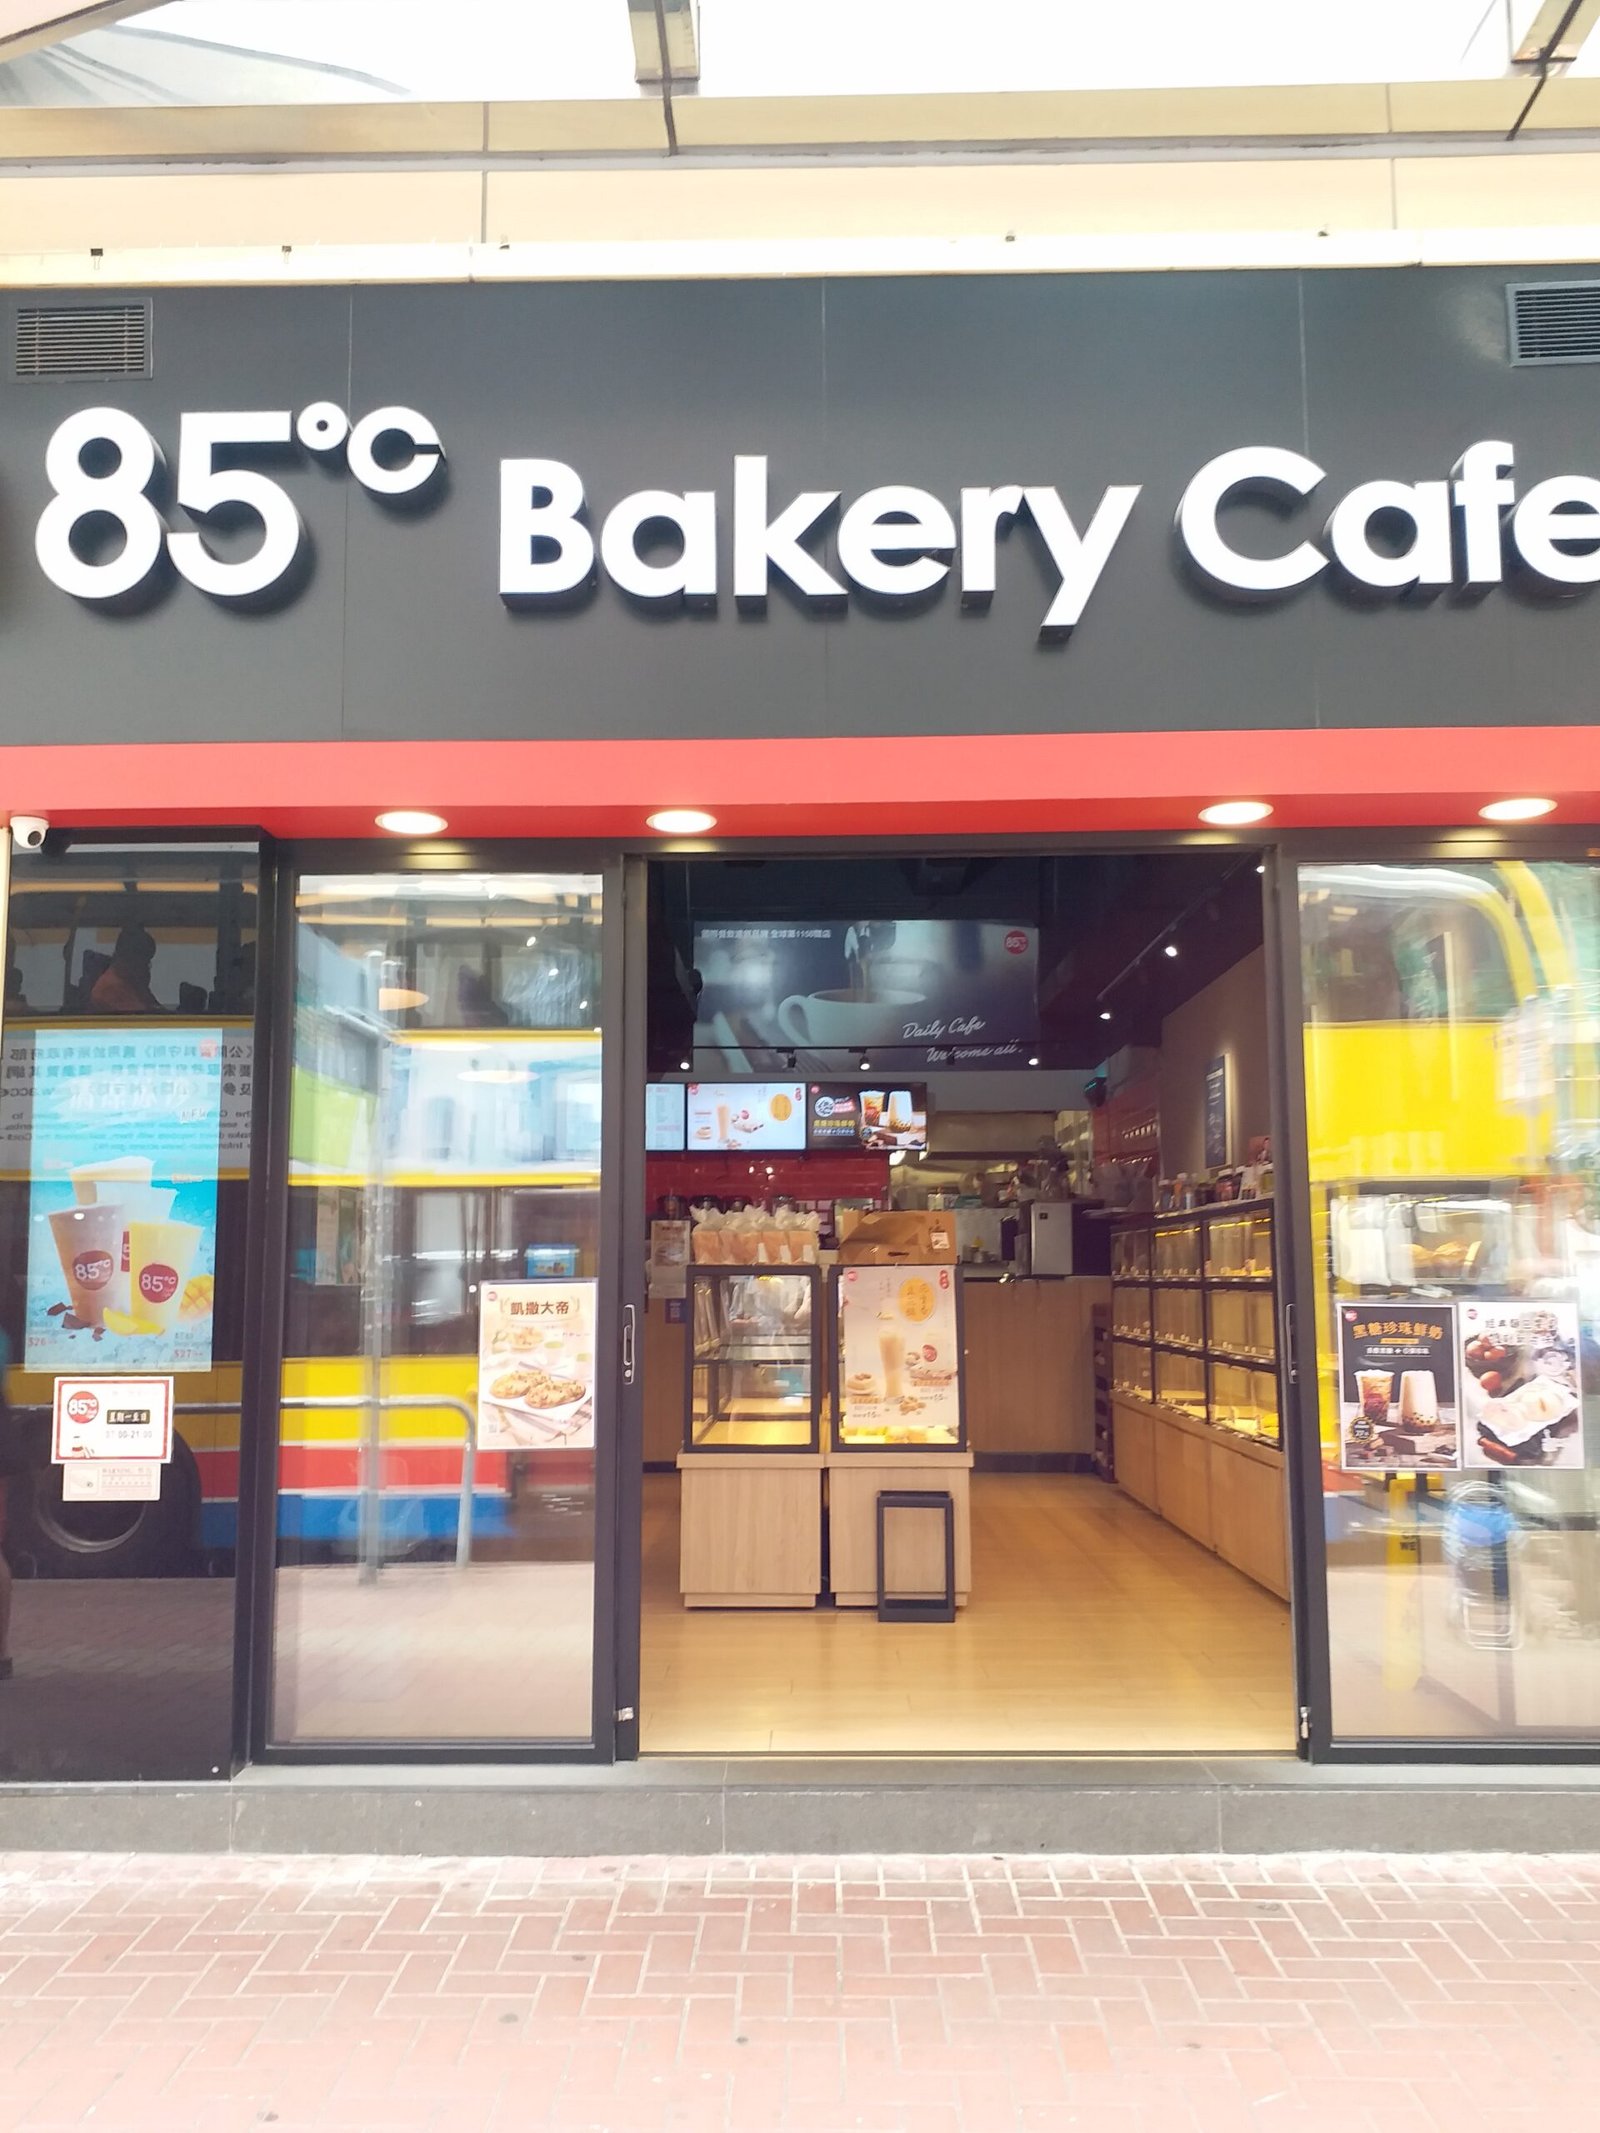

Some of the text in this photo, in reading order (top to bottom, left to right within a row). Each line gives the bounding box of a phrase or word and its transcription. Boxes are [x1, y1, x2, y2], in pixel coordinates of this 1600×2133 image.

[35, 400, 445, 599] 85°C
[499, 454, 1143, 628] Bakery
[902, 1015, 986, 1039] Daily Cafe
[510, 1301, 569, 1316] 凱撒大帝
[1352, 1320, 1445, 1341] 黑糖珍珠鮮奶
[107, 1411, 147, 1423] 星期一至日
